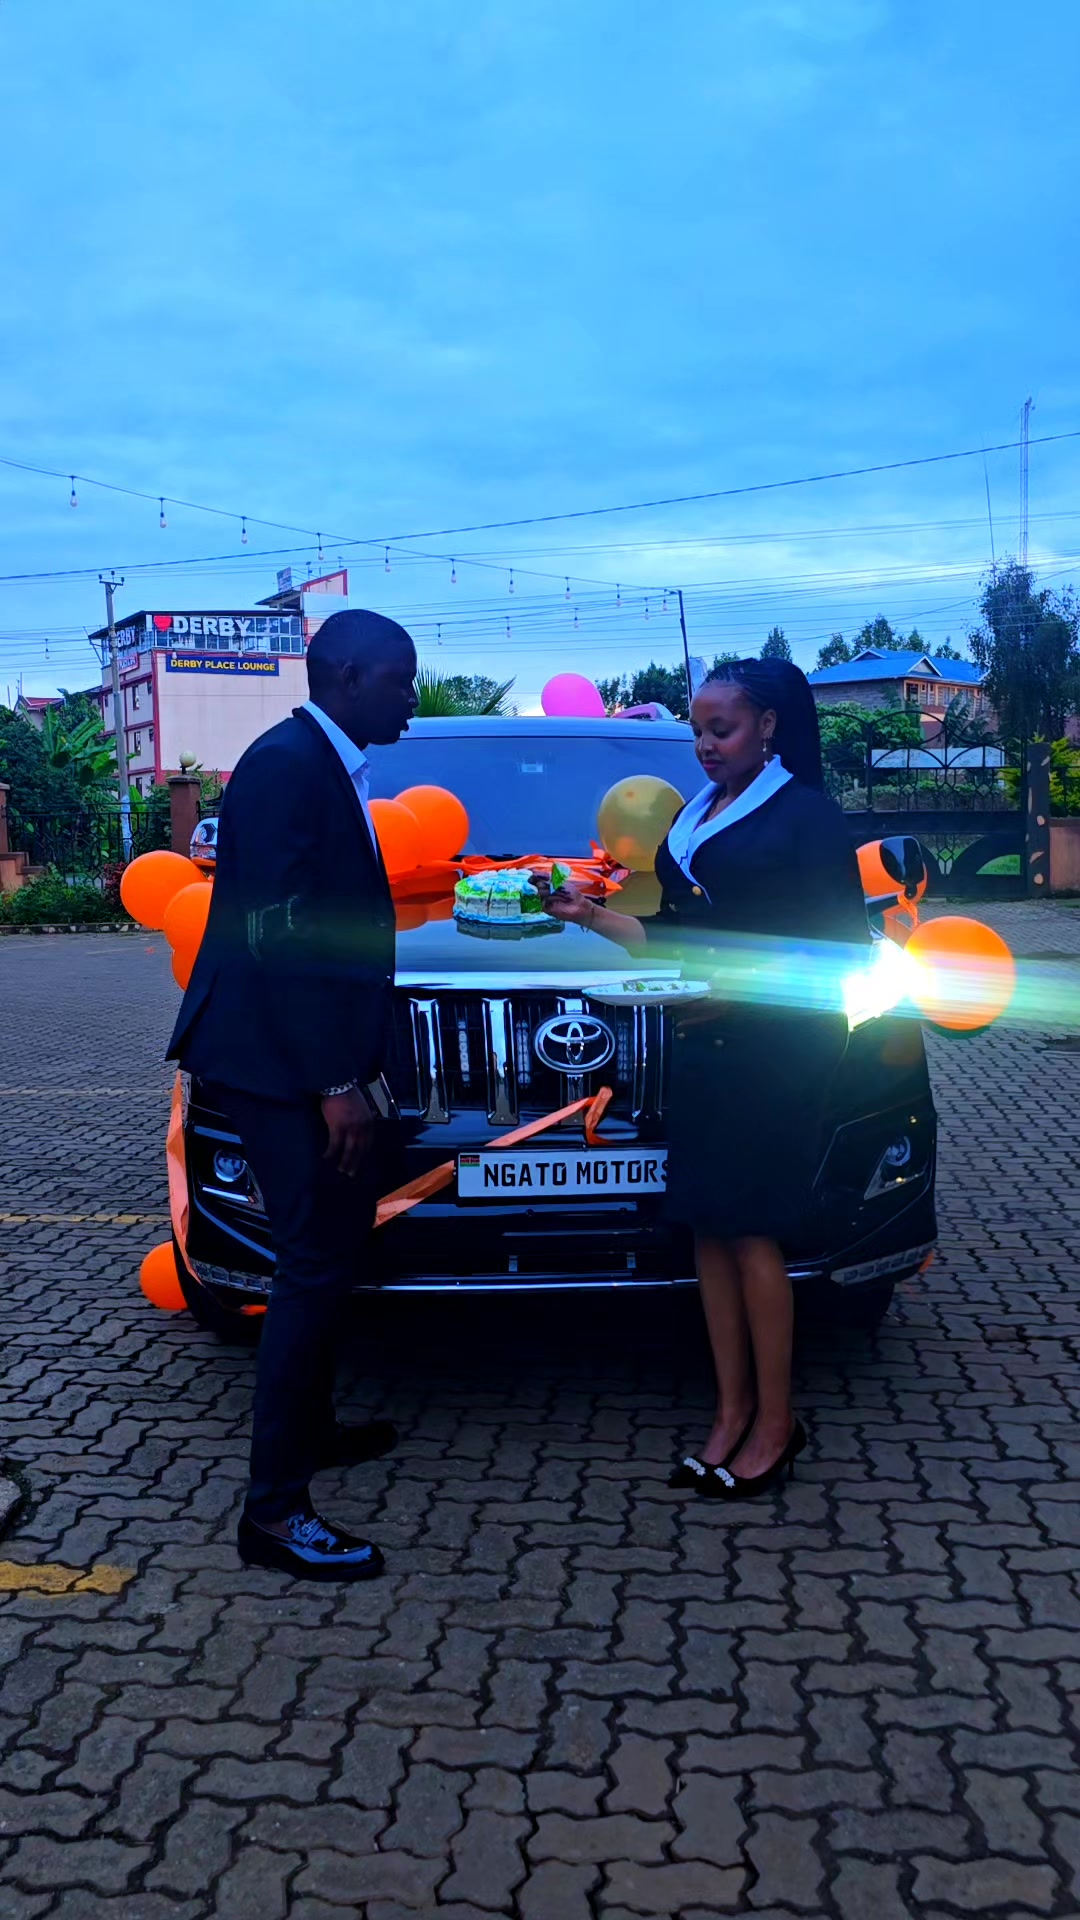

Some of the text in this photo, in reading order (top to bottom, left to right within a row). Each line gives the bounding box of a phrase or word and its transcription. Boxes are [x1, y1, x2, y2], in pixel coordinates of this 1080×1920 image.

[173, 616, 251, 636] DERBY
[170, 659, 276, 671] DERBY PLACE LOUNGE
[484, 1163, 567, 1187] NGATO
